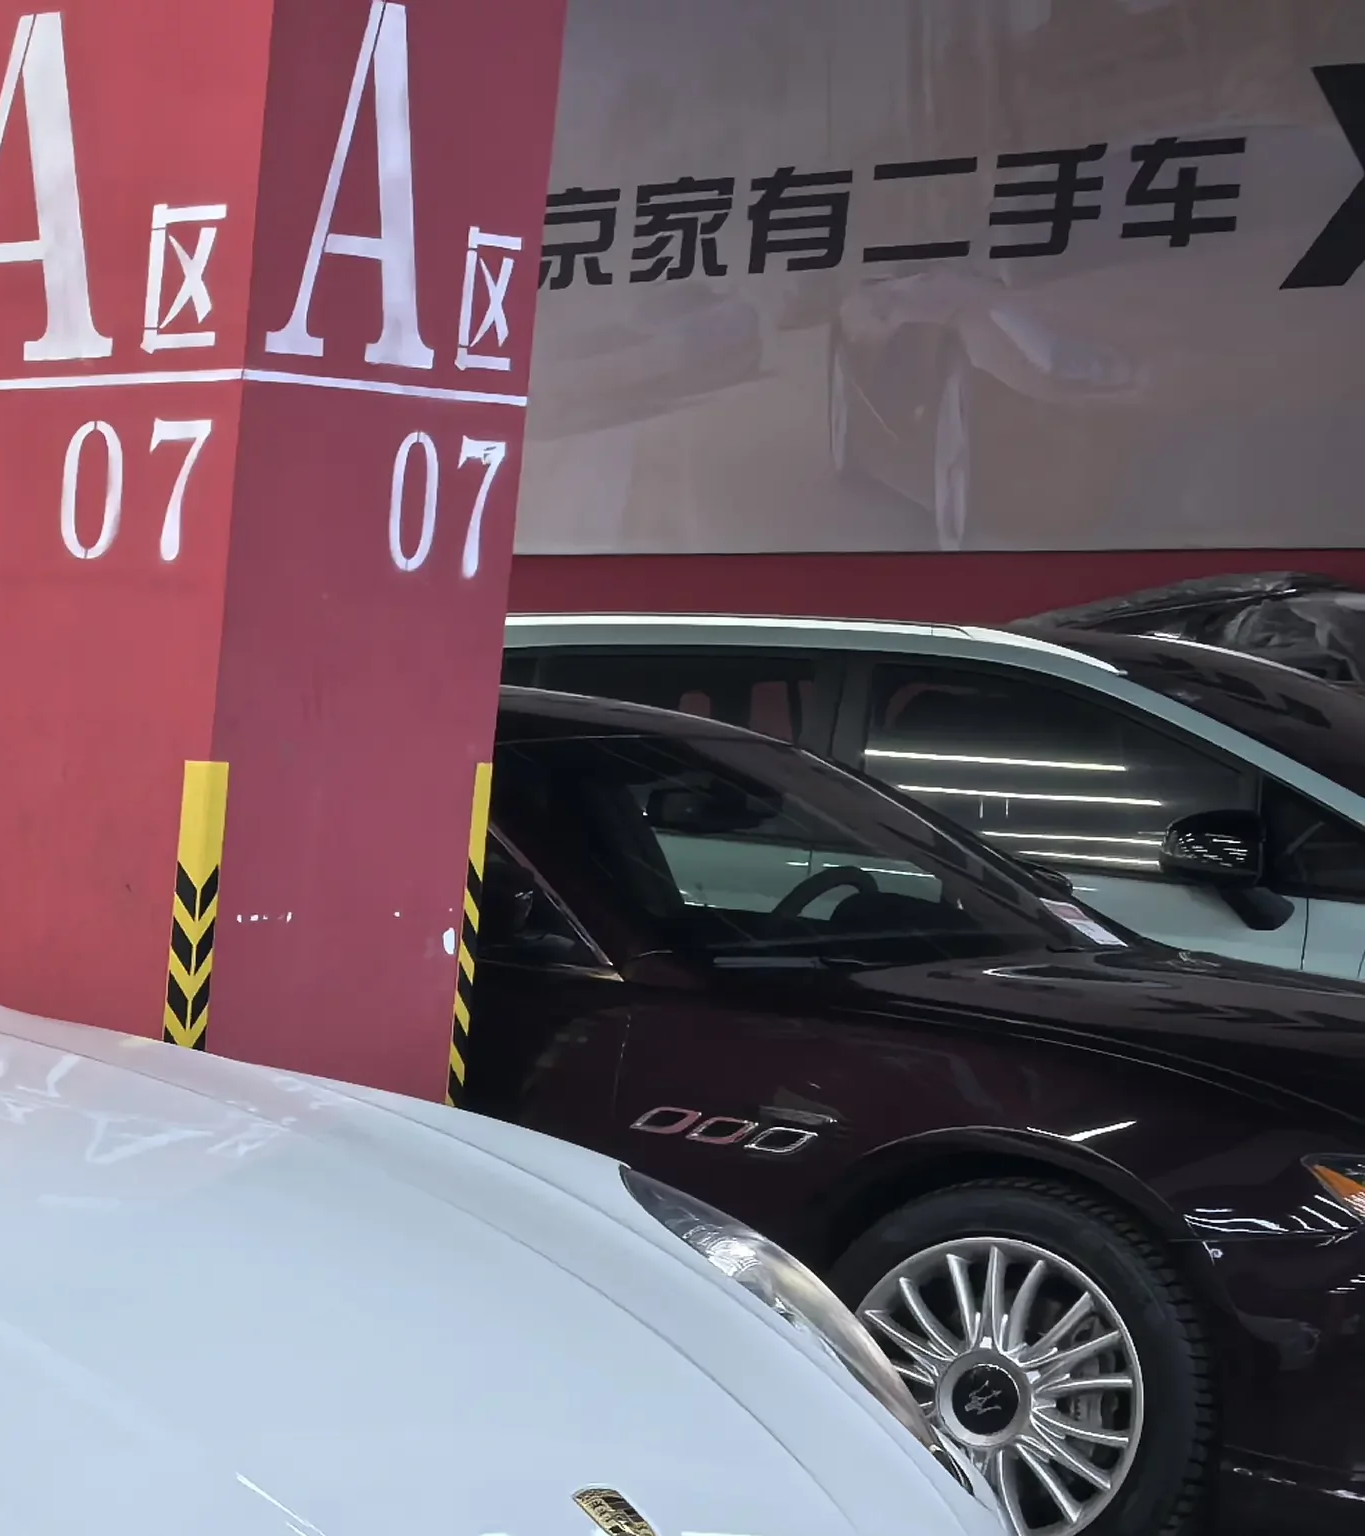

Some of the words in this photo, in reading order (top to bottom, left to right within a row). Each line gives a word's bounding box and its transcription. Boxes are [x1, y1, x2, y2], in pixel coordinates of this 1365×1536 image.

[264, 2, 522, 371] A区
[539, 136, 1247, 291] 京家有二手车
[60, 417, 212, 562] 07
[388, 430, 507, 578] 07
